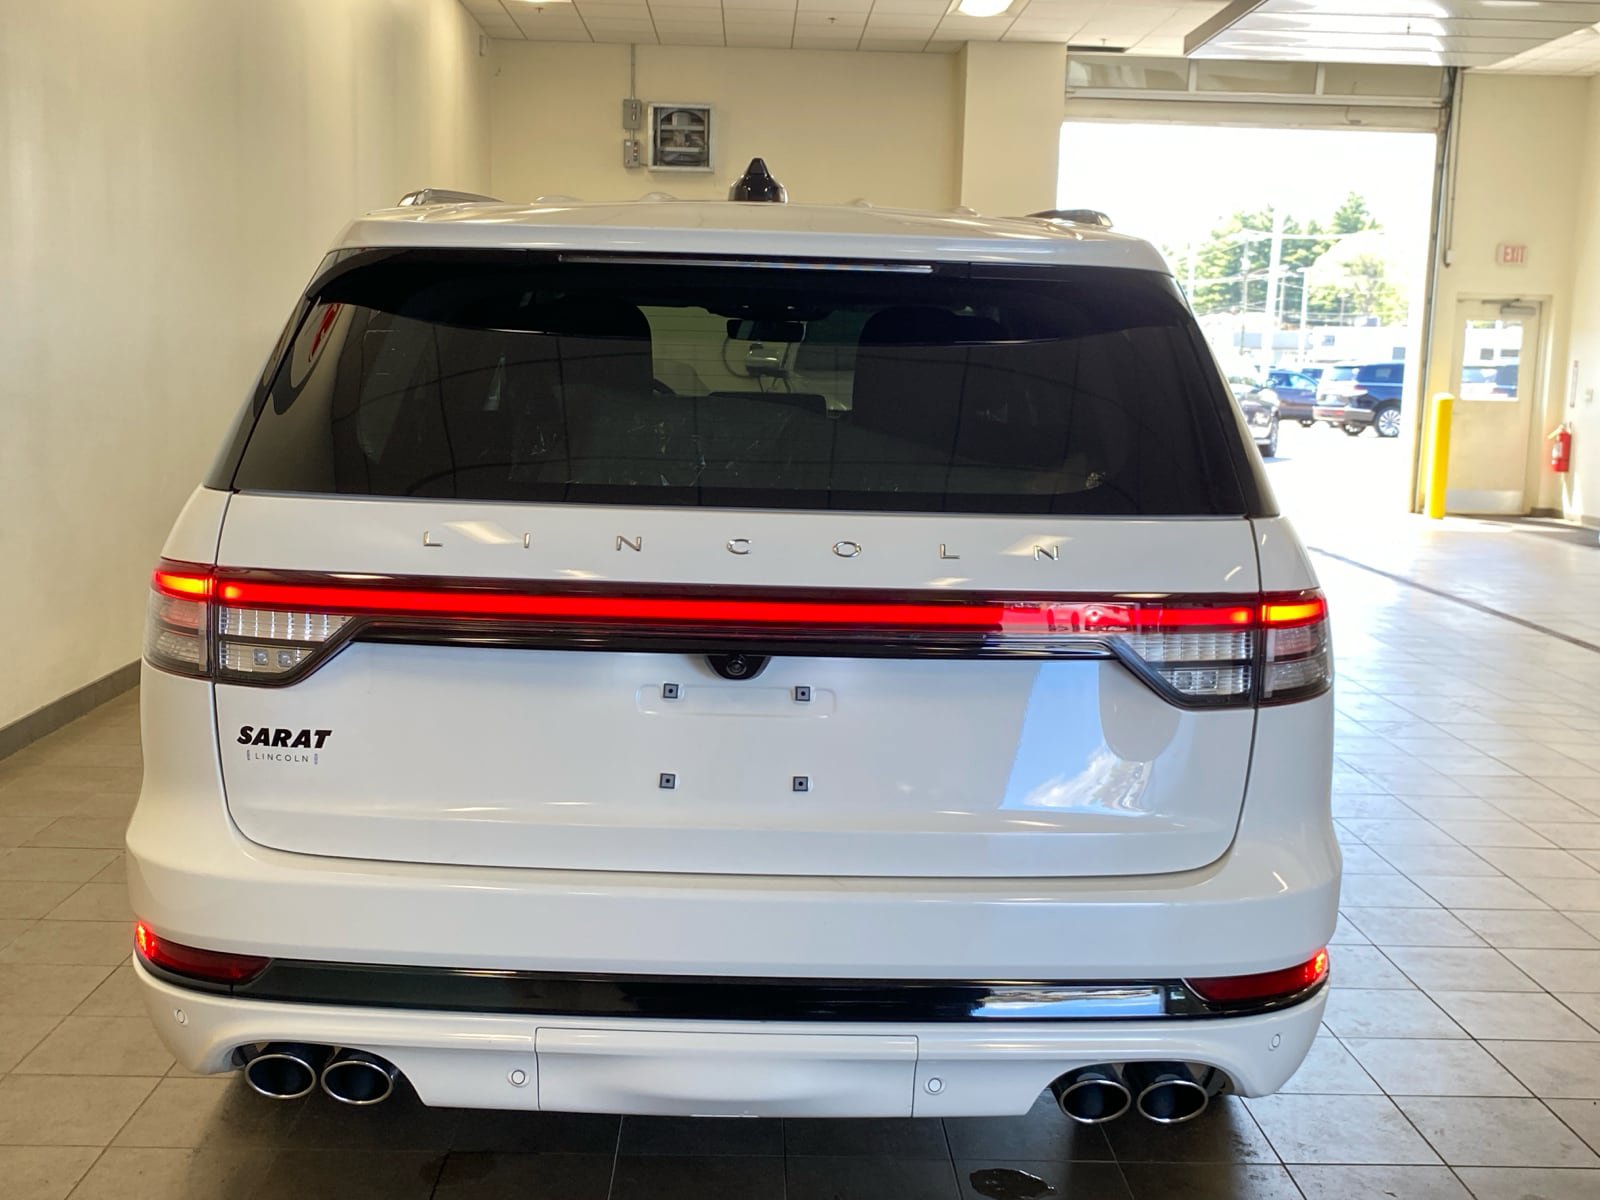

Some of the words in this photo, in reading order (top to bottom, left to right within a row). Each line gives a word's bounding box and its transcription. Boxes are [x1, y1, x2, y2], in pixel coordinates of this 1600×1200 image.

[1503, 245, 1526, 264] EXIT
[423, 531, 1059, 561] LINCOLN
[236, 725, 332, 749] SARAT
[255, 752, 309, 763] LINCOLN
